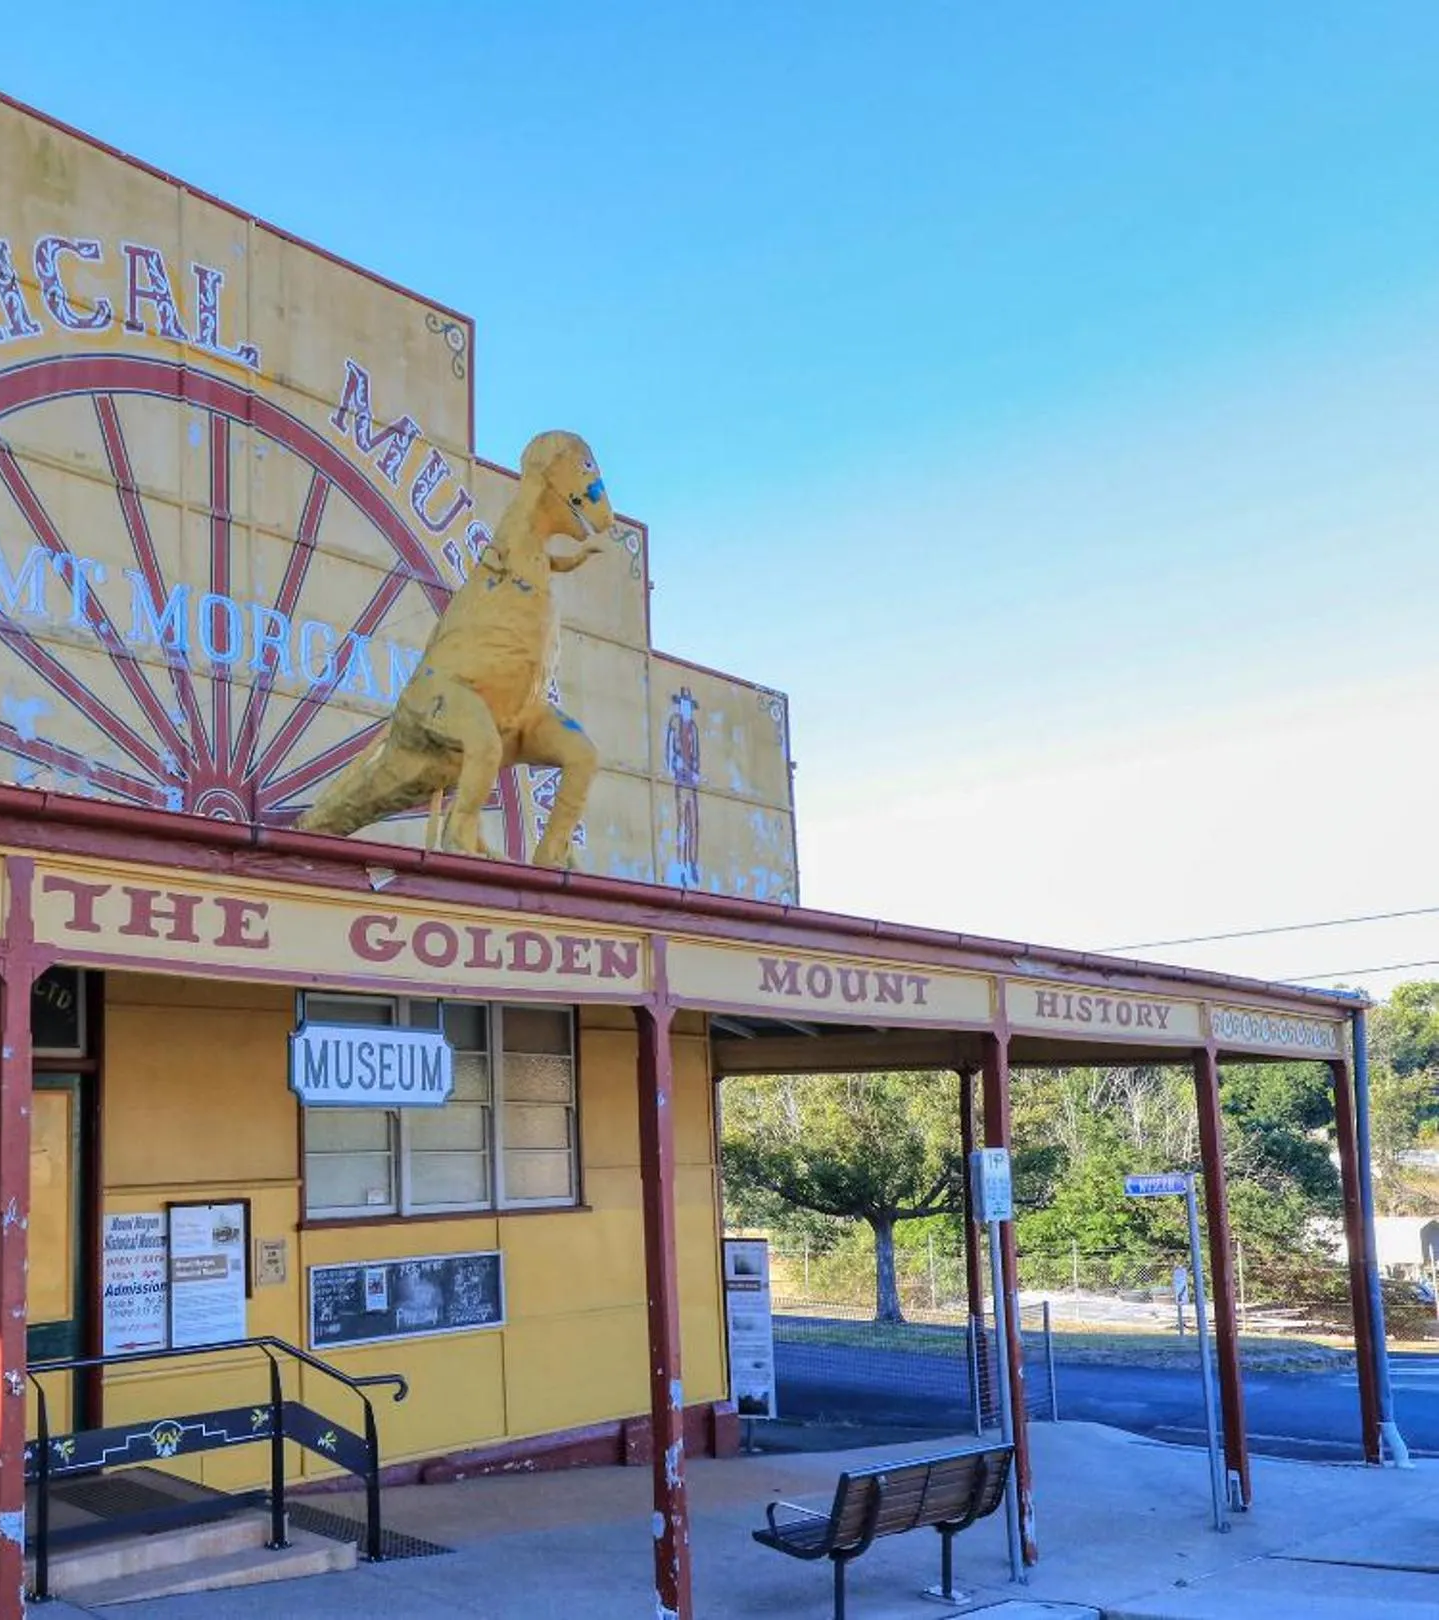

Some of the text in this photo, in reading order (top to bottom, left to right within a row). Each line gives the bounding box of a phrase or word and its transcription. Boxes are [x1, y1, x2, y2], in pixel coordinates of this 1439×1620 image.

[42, 874, 1172, 1031] THE GOLDEN MOUNT HISTORY
[303, 1038, 443, 1092] MUSEUM
[105, 1279, 168, 1297] Admission
